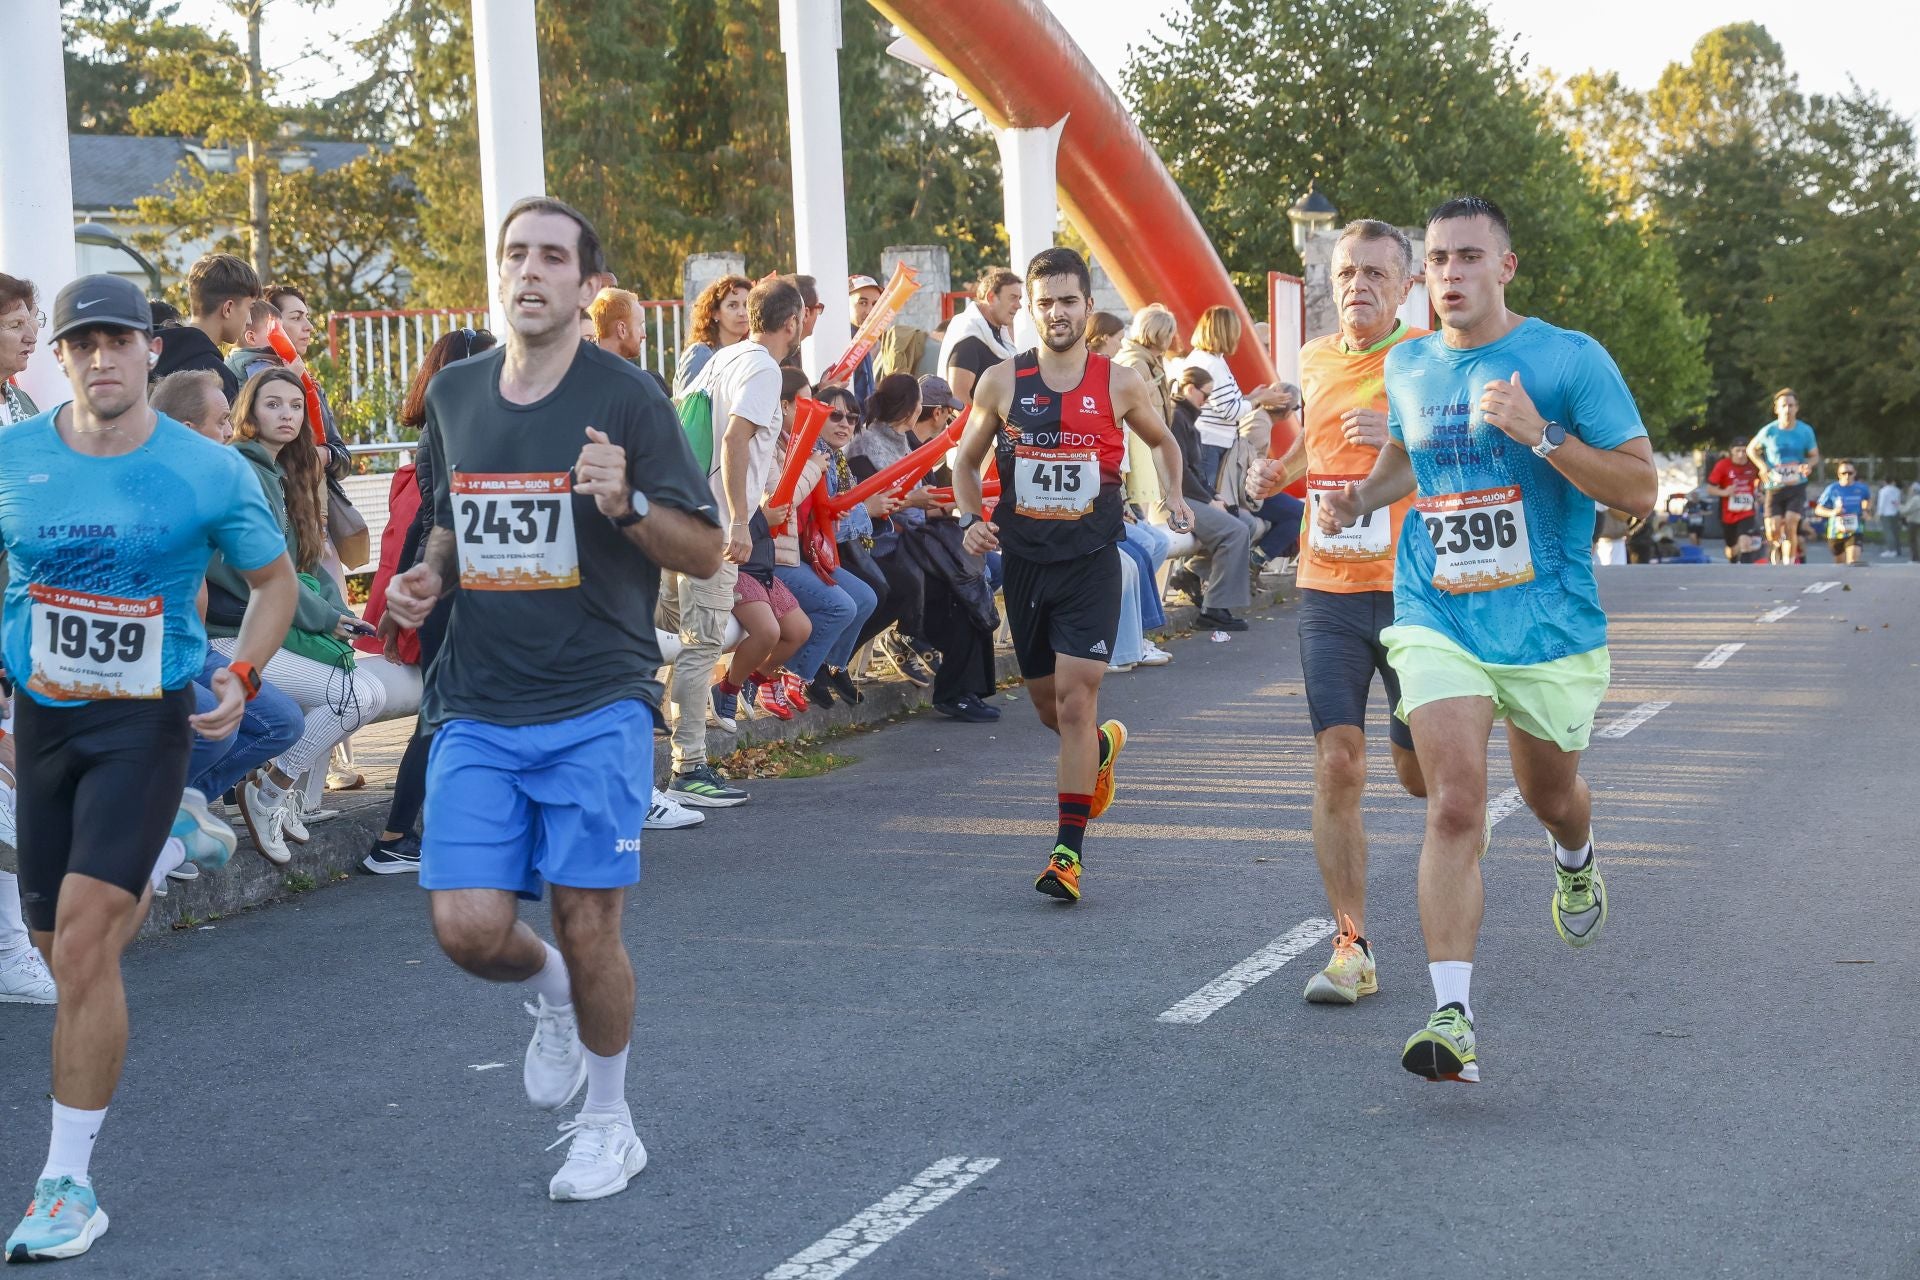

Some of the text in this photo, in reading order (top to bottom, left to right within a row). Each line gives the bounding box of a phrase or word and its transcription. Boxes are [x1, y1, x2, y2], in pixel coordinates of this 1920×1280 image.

[845, 339, 871, 369] MBA
[1036, 432, 1095, 447] OVIEDO
[481, 480, 506, 489] MBA
[1032, 463, 1081, 492] 413
[1445, 498, 1464, 507] MBA
[1482, 492, 1506, 502] GIJÓN
[68, 525, 117, 538] MBA
[461, 500, 561, 544] 2437
[1425, 509, 1518, 556] 2396
[68, 596, 96, 608] MBA
[118, 602, 147, 613] GIJÓN
[46, 611, 146, 664] 1939
